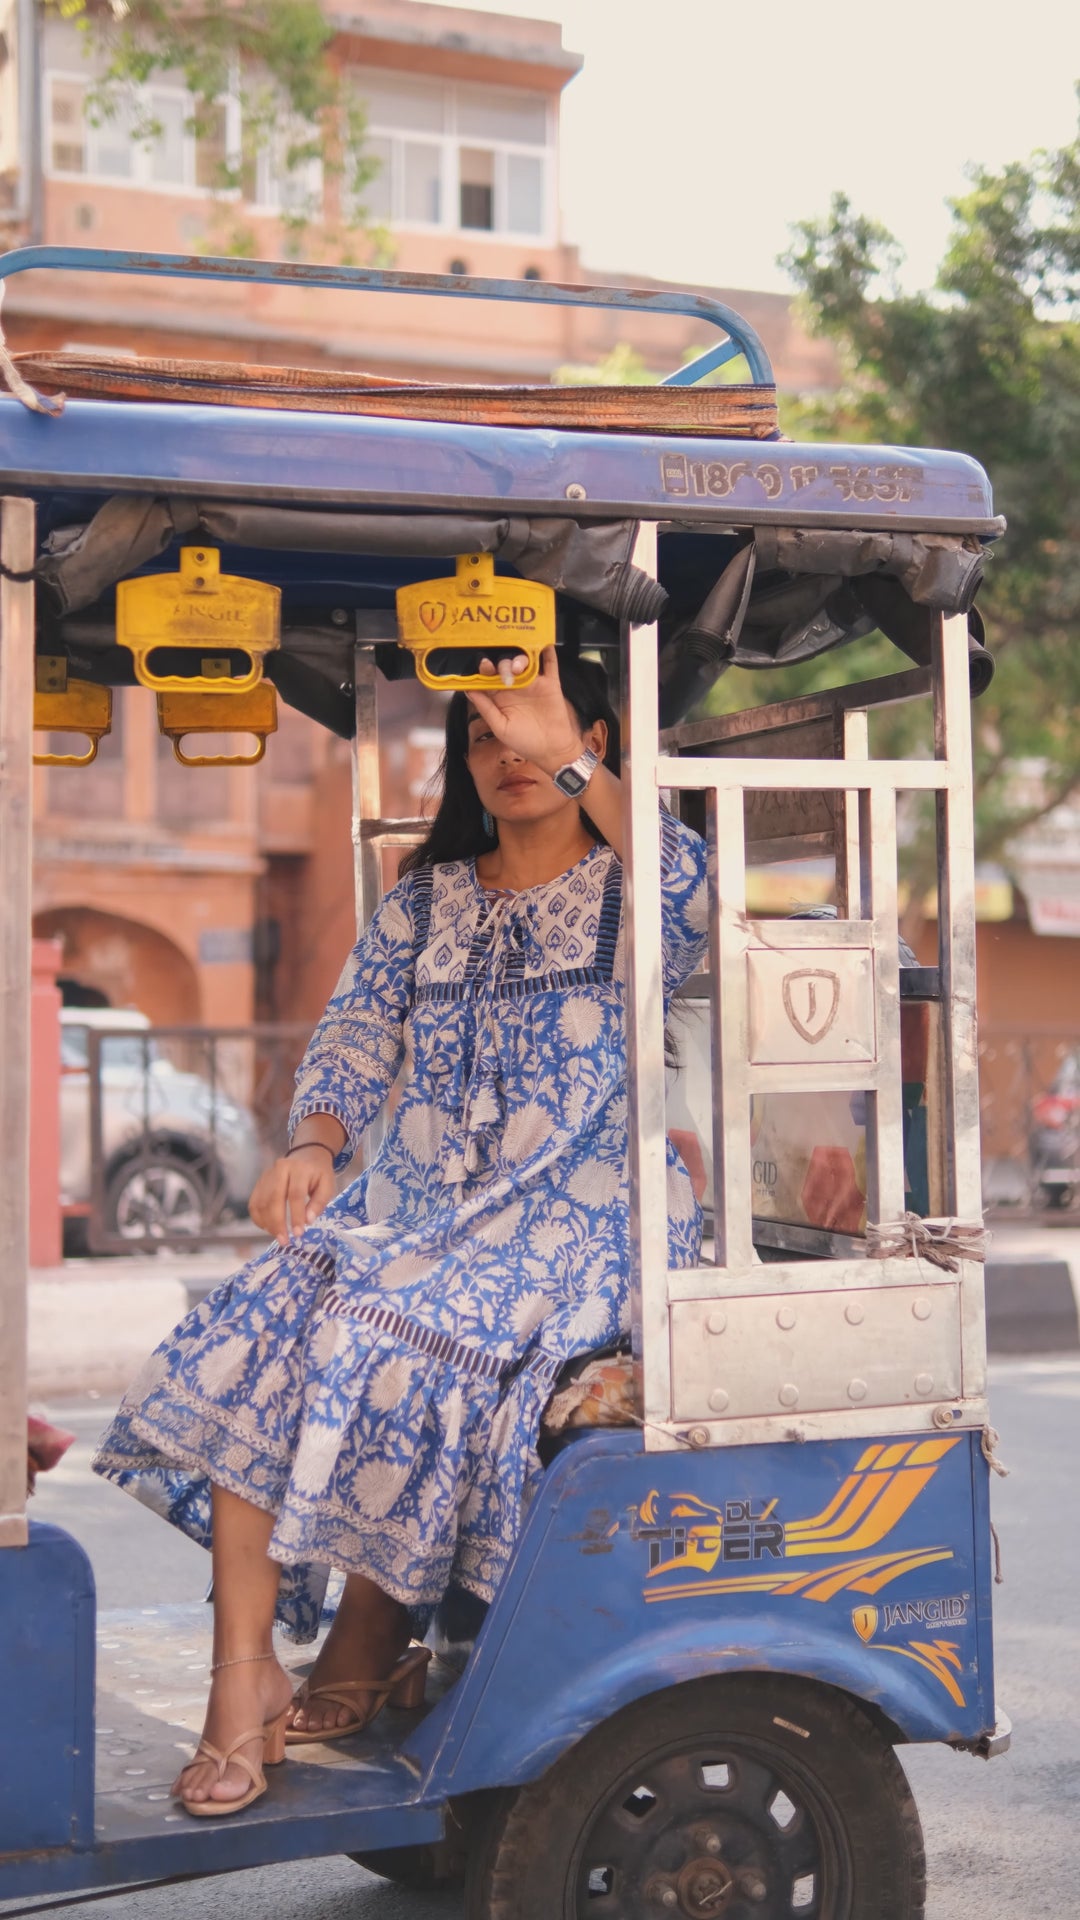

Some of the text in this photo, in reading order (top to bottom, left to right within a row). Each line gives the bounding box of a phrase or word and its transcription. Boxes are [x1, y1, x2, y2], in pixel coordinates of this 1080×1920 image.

[451, 604, 536, 626] JANGID
[725, 1498, 779, 1524] DLX
[636, 1520, 784, 1573] TIGER
[883, 1597, 966, 1633] JANGID
